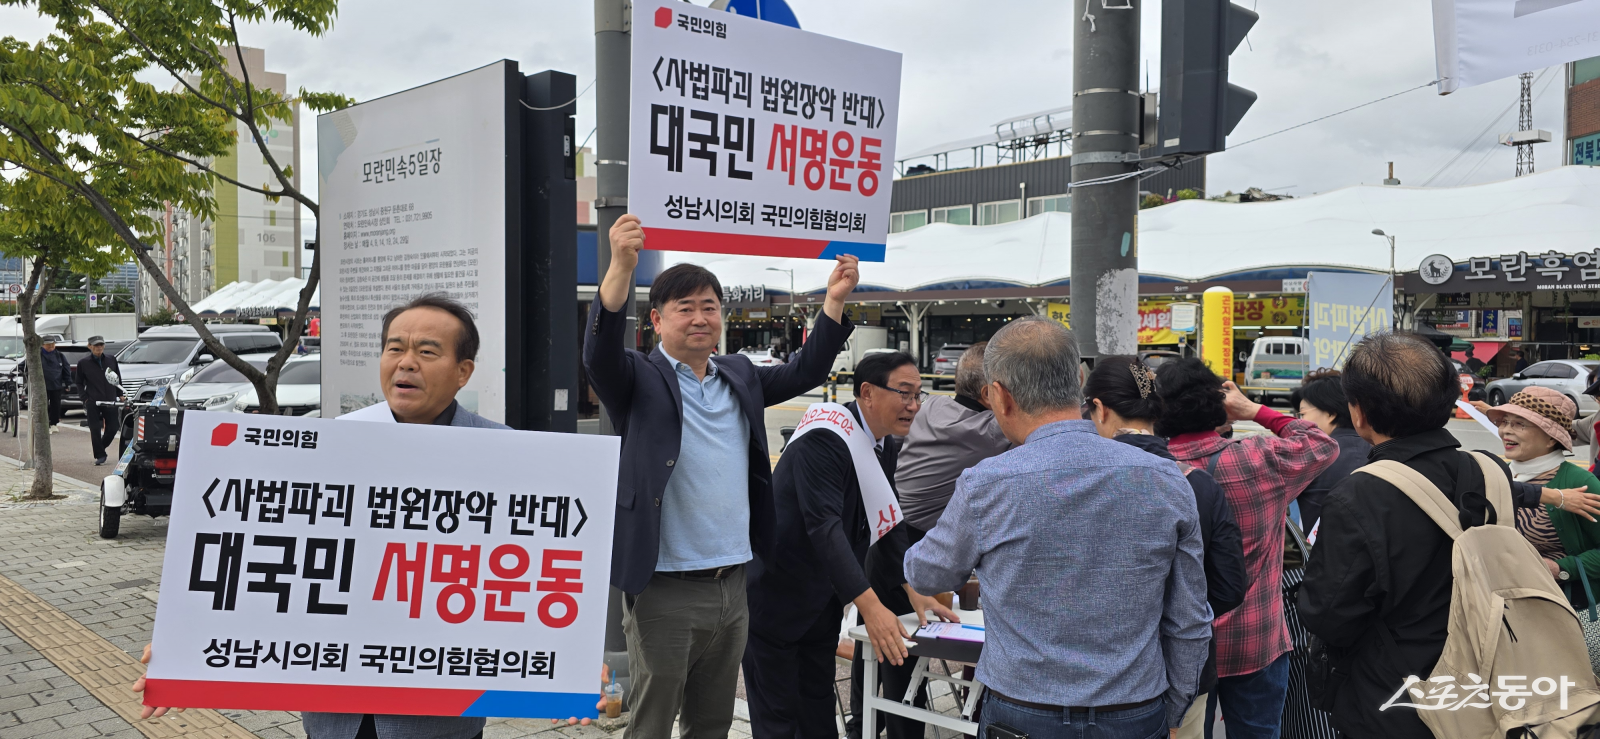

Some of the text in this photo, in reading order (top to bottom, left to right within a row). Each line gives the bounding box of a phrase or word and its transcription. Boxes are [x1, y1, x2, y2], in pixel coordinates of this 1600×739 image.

[677, 13, 727, 39] 국민의힘
[761, 75, 836, 122] 법원장악
[362, 147, 442, 184] 모란민속5일장
[650, 103, 882, 197] 대국민 서명운동
[664, 195, 867, 234] 성남시의회 국민의힘협의회
[257, 232, 276, 243] 106
[244, 427, 319, 450] 국민의힘
[367, 486, 497, 535] 법원장악
[188, 532, 584, 629] 대국민 서명운동
[202, 638, 556, 680] 성남시의회 국민의힘협의회
